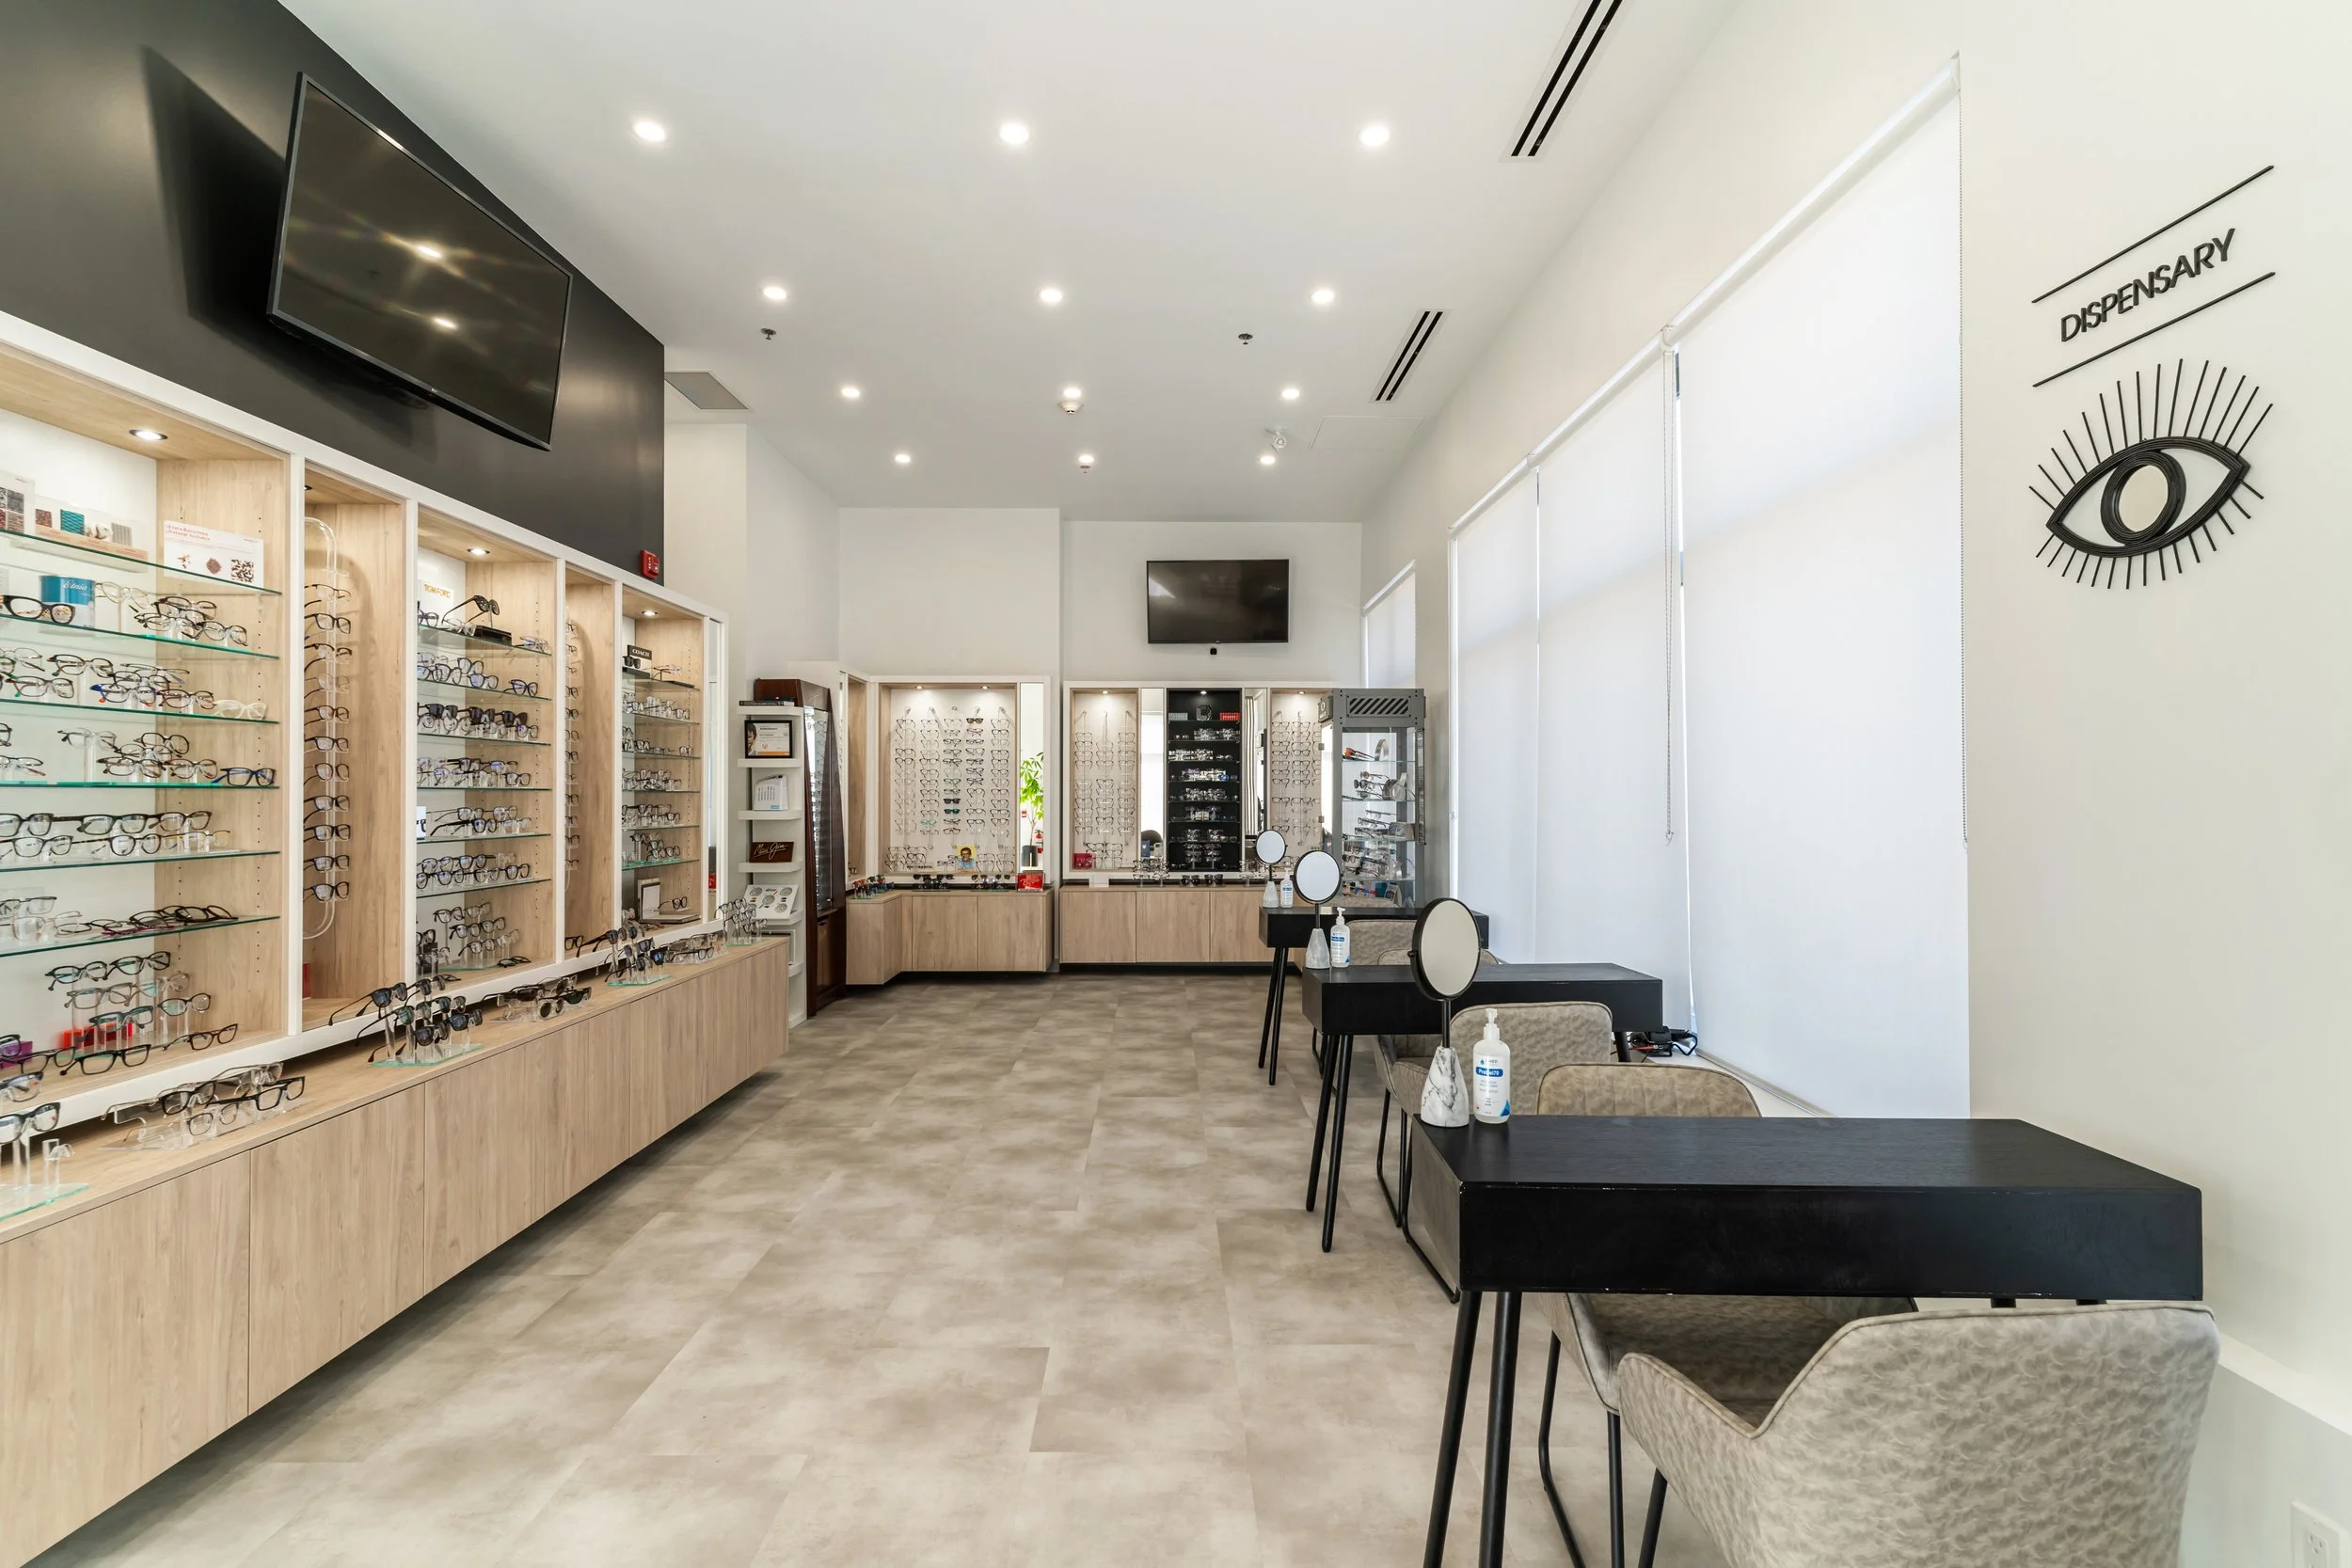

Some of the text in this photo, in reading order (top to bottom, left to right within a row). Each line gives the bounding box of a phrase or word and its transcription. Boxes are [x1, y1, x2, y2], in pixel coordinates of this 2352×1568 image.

[2060, 228, 2235, 342] DISPENSARY
[423, 583, 452, 599] TOM FORD
[631, 648, 650, 657] COACH
